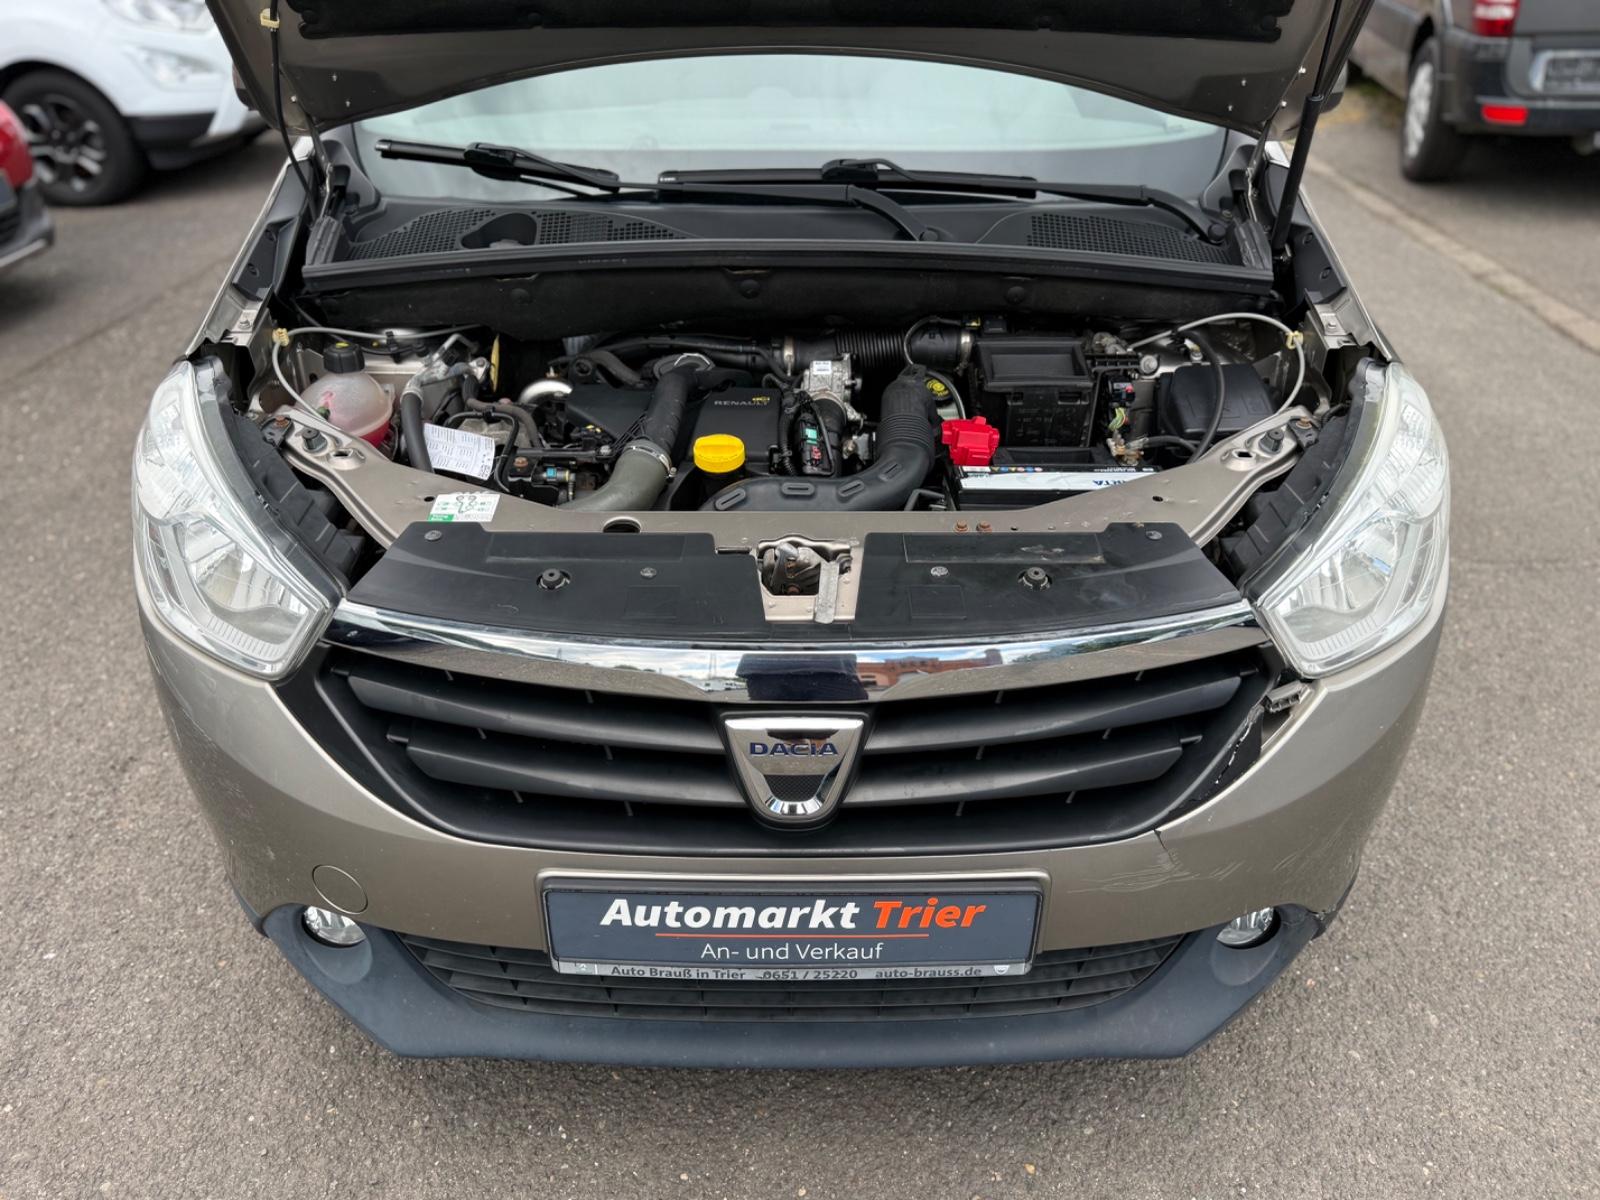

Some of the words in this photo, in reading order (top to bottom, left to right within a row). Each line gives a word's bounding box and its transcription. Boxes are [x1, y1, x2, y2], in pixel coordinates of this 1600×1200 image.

[750, 742, 838, 756] DACIA
[600, 898, 861, 929] Automarkt
[873, 897, 987, 929] Trier
[701, 943, 739, 960] An-
[746, 942, 790, 960] und
[796, 942, 885, 960] Verkauf
[611, 966, 645, 977] Auto
[649, 967, 692, 979] Brauß
[696, 967, 710, 979] in
[712, 969, 746, 980] Trier
[762, 970, 799, 981] 0651
[814, 970, 858, 980] 25220
[875, 966, 981, 979] auto-brauss.de
